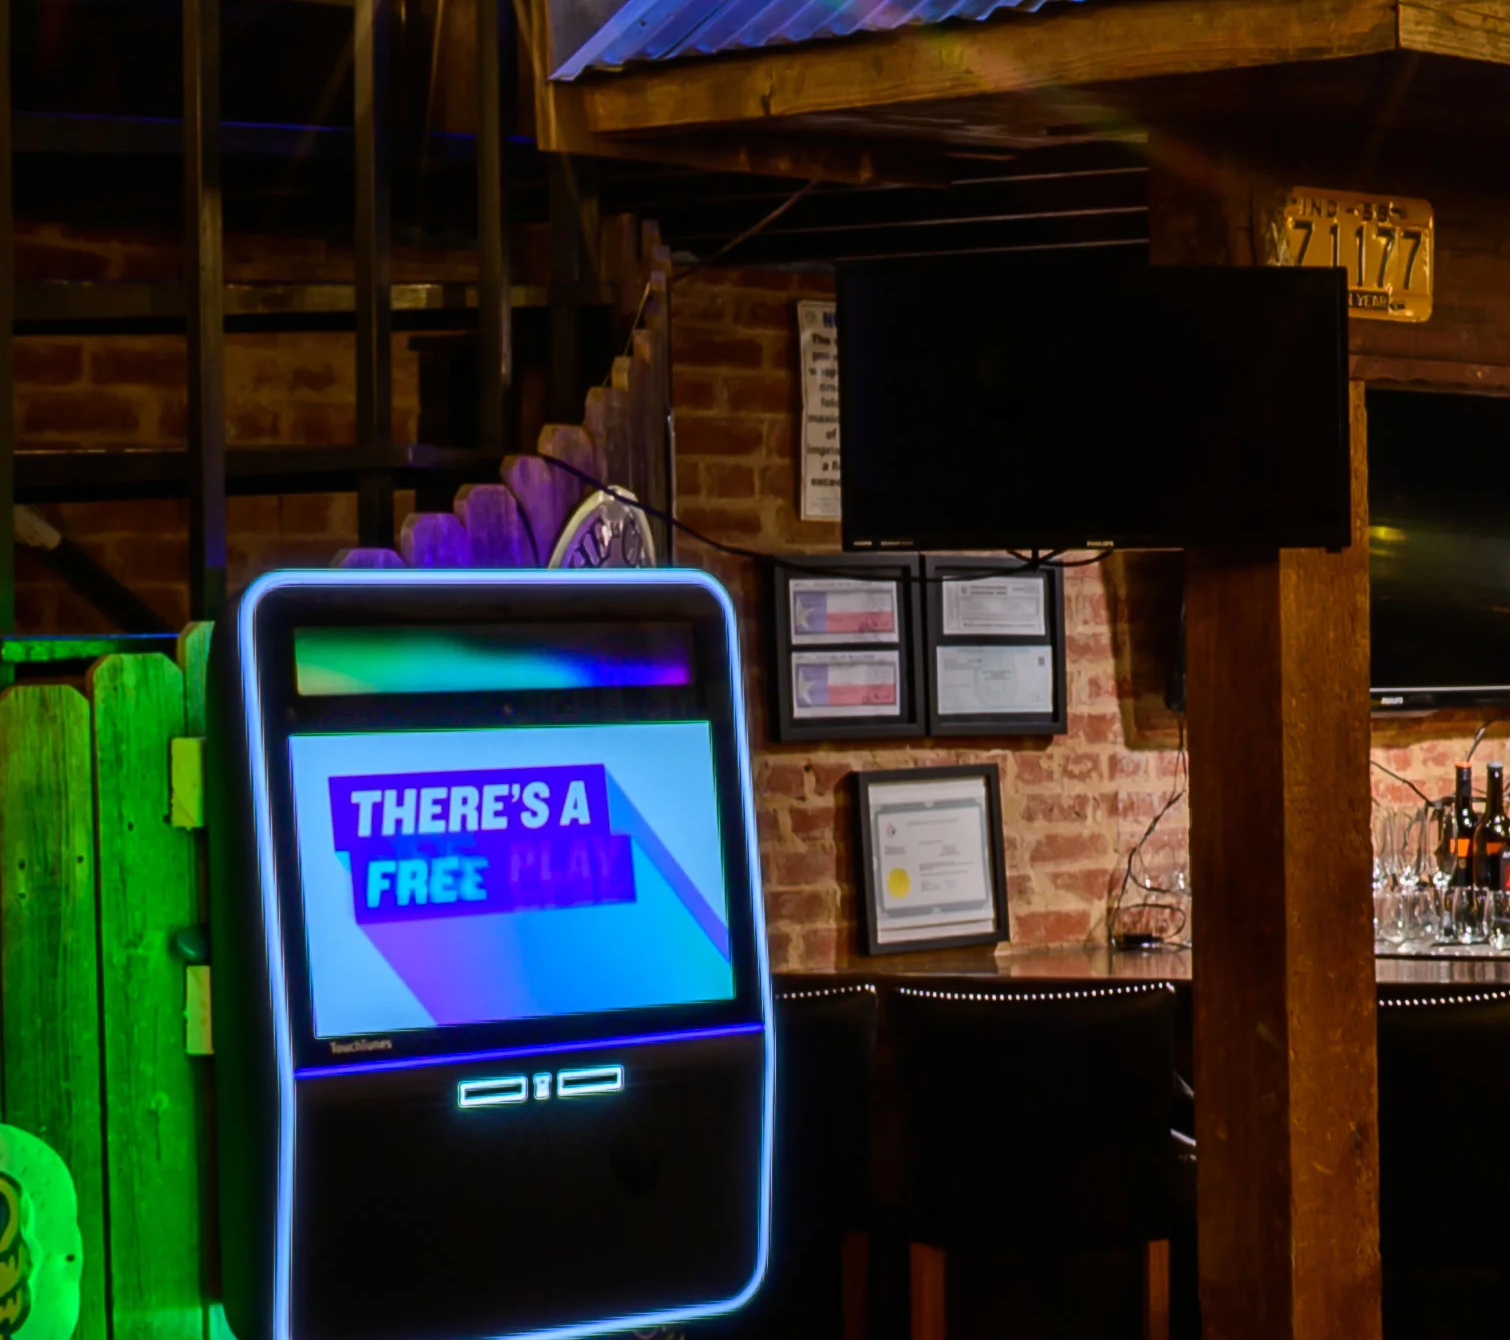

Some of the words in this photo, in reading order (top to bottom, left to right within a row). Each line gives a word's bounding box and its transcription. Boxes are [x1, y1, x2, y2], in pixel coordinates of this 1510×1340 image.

[1357, 291, 1389, 307] YEAR
[350, 781, 551, 838] THERE'S
[559, 779, 592, 828] A
[366, 855, 490, 909] FREE
